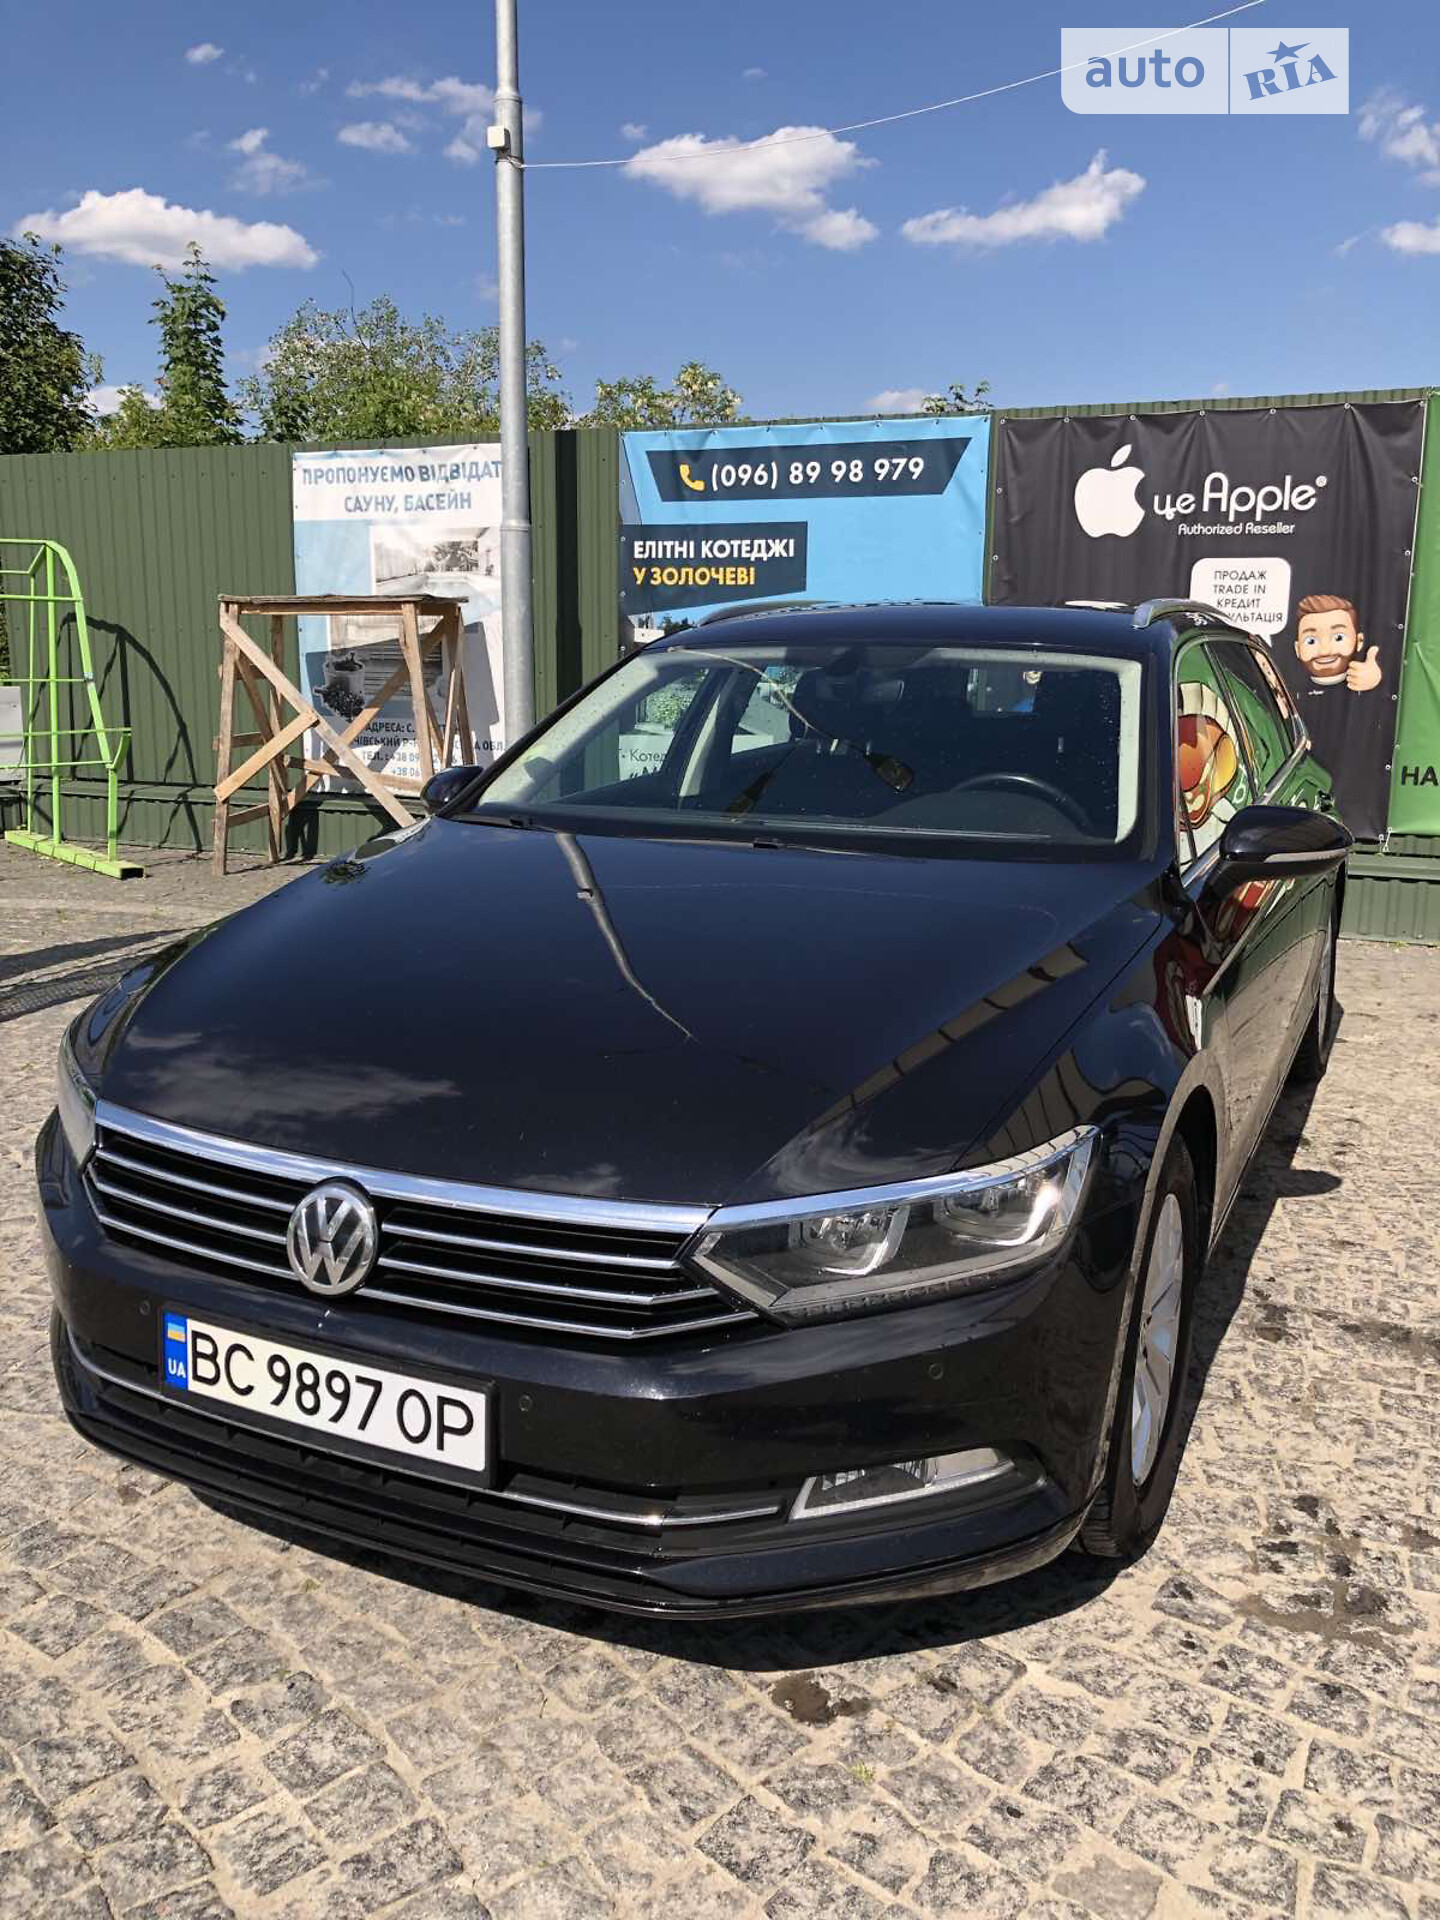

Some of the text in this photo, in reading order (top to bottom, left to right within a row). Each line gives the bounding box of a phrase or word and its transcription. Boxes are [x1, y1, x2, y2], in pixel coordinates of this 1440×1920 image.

[303, 461, 501, 485] ПРОПОНУЄМО ВІДВІДАТ
[711, 457, 924, 491] (096) 89 98 979
[344, 489, 472, 514] САУНУ, БАСЕЙН
[1178, 521, 1295, 535] Authorized Reseller
[633, 538, 795, 561] ЕЛІТНІ КОТЕДЖІ
[633, 567, 756, 586] У ЗОЛОЧЕВІ
[1214, 570, 1267, 581] ПРОДАЖ
[1213, 584, 1266, 595] TRADE IN
[1217, 598, 1260, 609] КРЕДИТ
[1227, 612, 1283, 623] УЛЬТАЦІЯ
[167, 1358, 186, 1379] UA
[192, 1330, 474, 1451] BC 9897 OP
